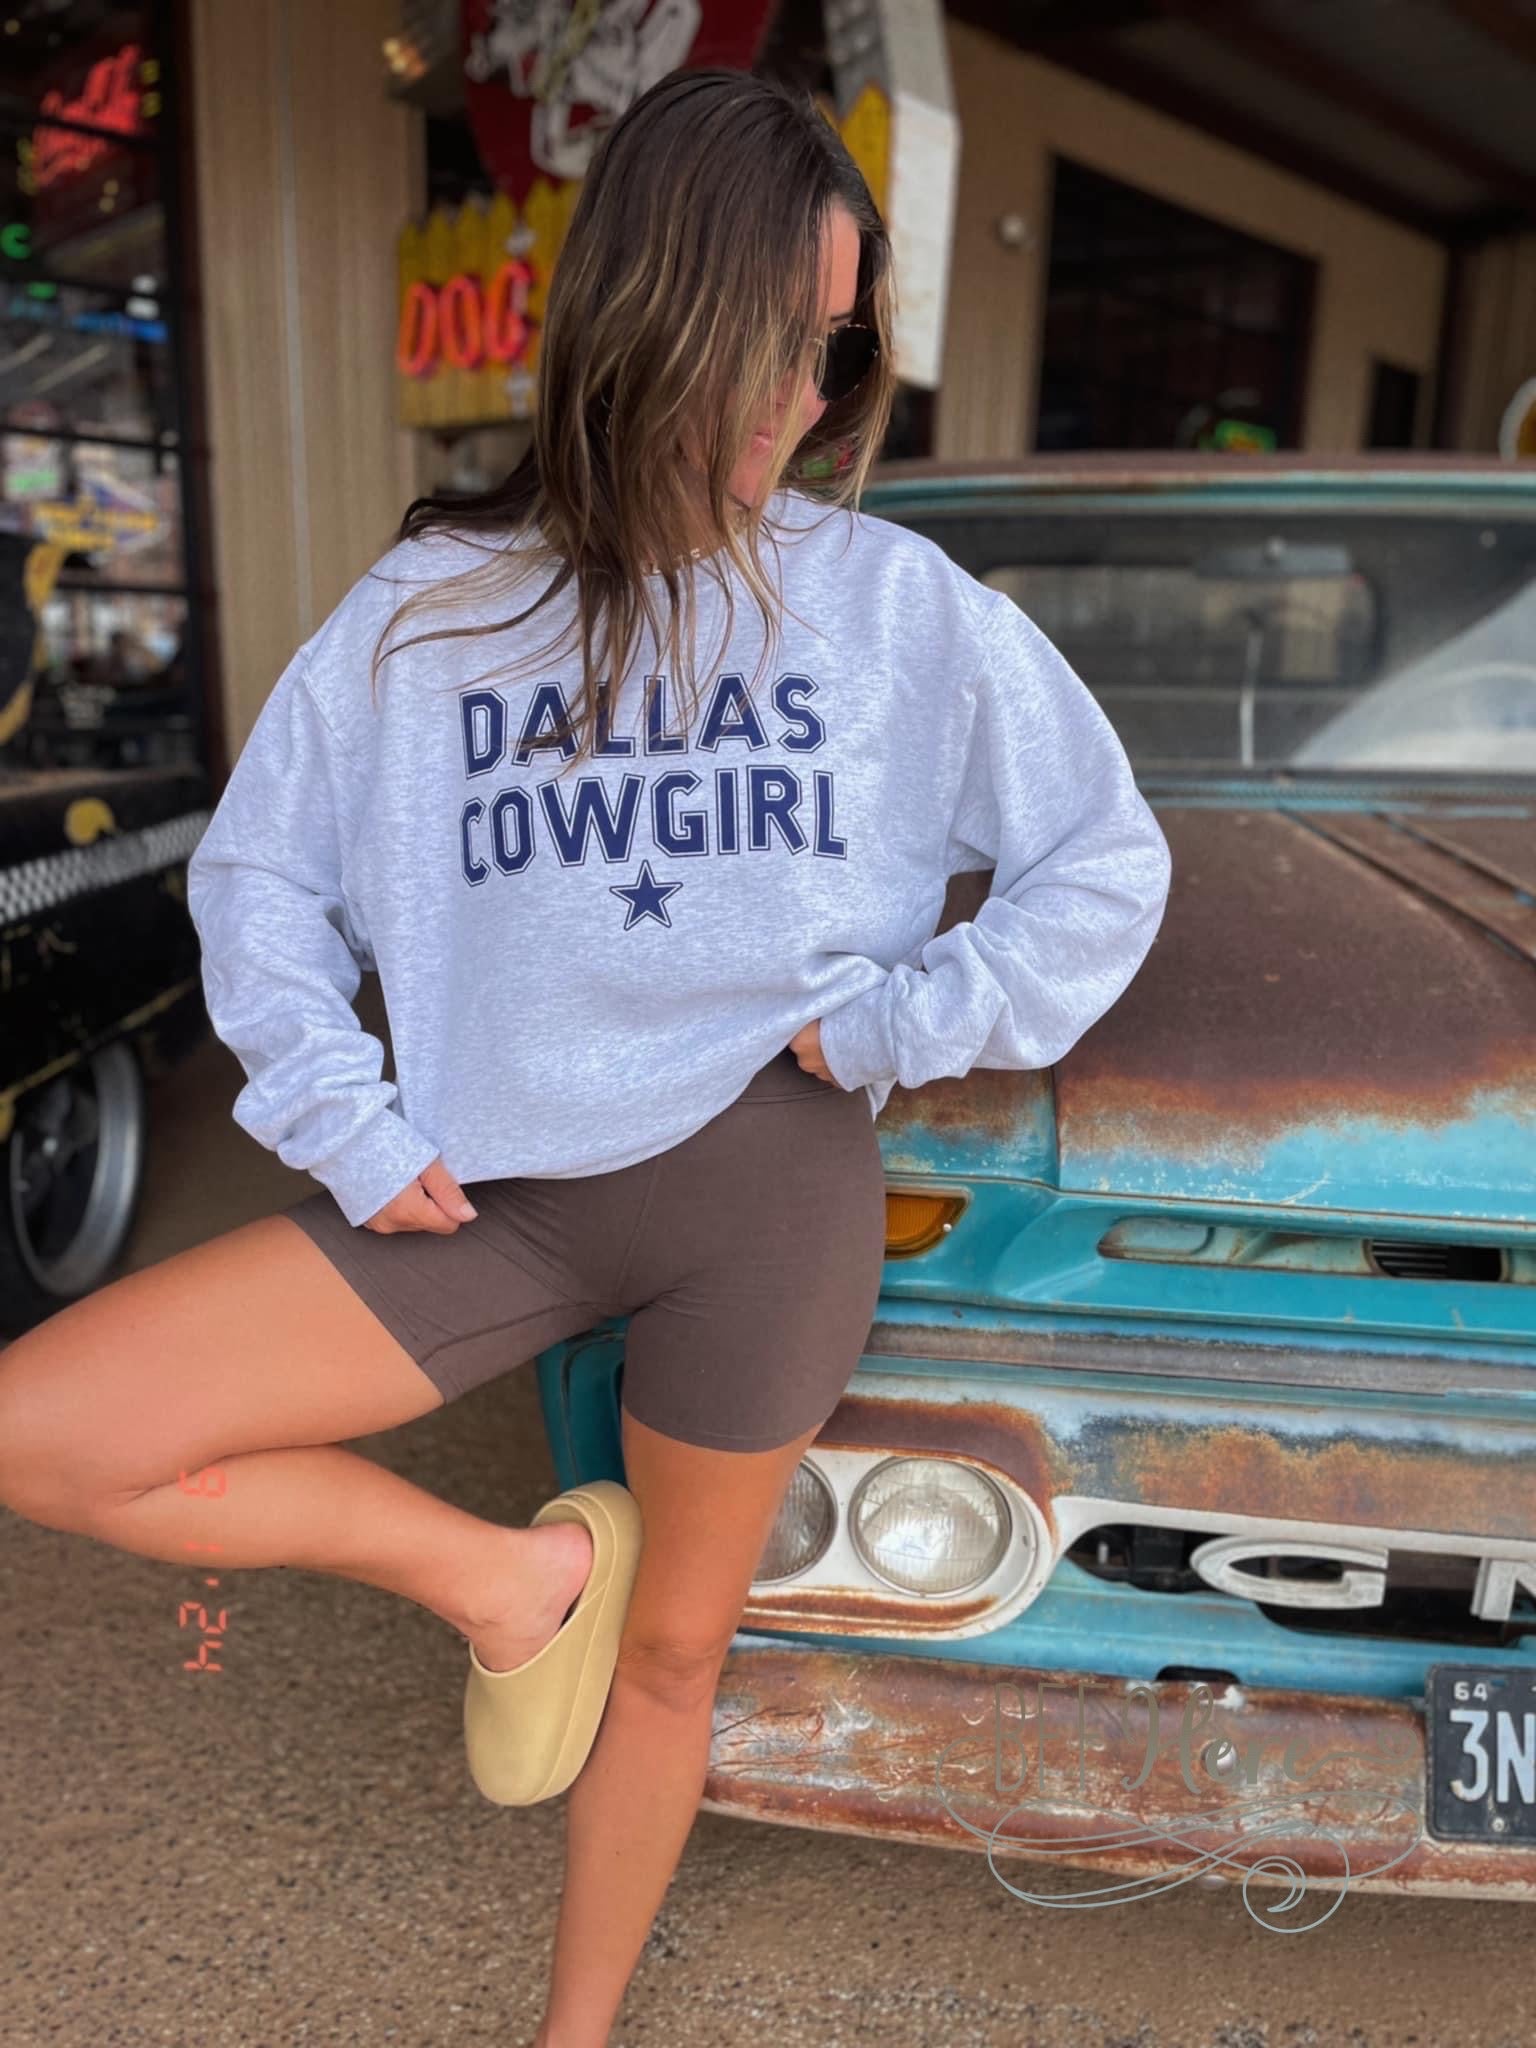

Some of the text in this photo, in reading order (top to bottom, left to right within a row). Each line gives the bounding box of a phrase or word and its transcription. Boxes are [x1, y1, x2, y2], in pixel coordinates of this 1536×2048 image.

[459, 673, 826, 779] DALLAS
[460, 765, 848, 887] COWGIRL
[1453, 1681, 1489, 1701] 64
